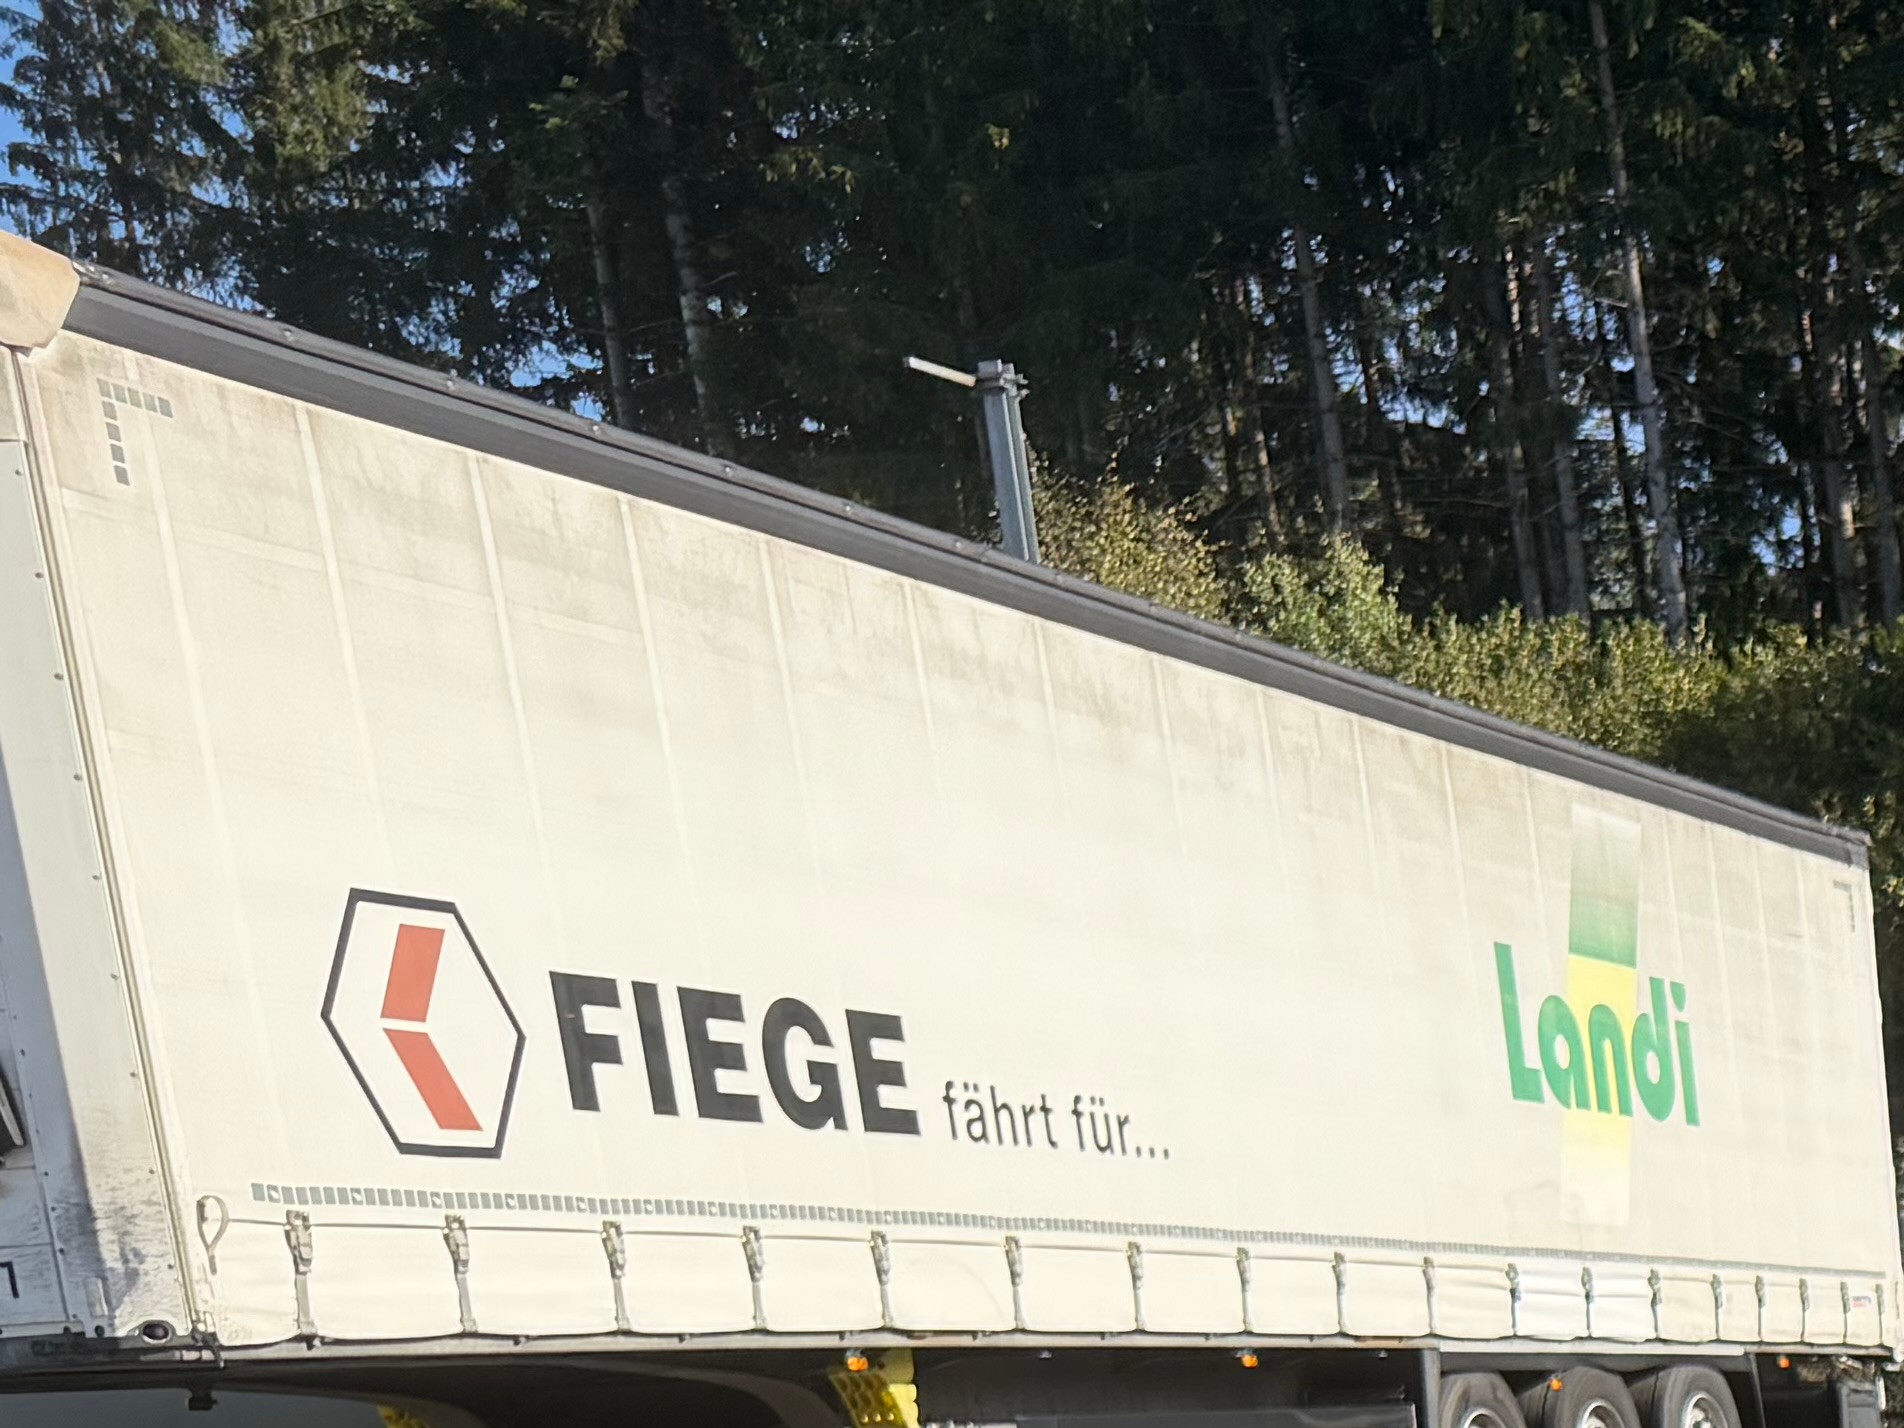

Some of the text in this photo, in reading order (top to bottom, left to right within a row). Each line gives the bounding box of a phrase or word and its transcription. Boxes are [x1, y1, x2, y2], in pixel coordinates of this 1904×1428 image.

[549, 971, 921, 1136] FIEGE
[1493, 941, 1701, 1128] Landi
[942, 1080, 1170, 1160] fährt für...
